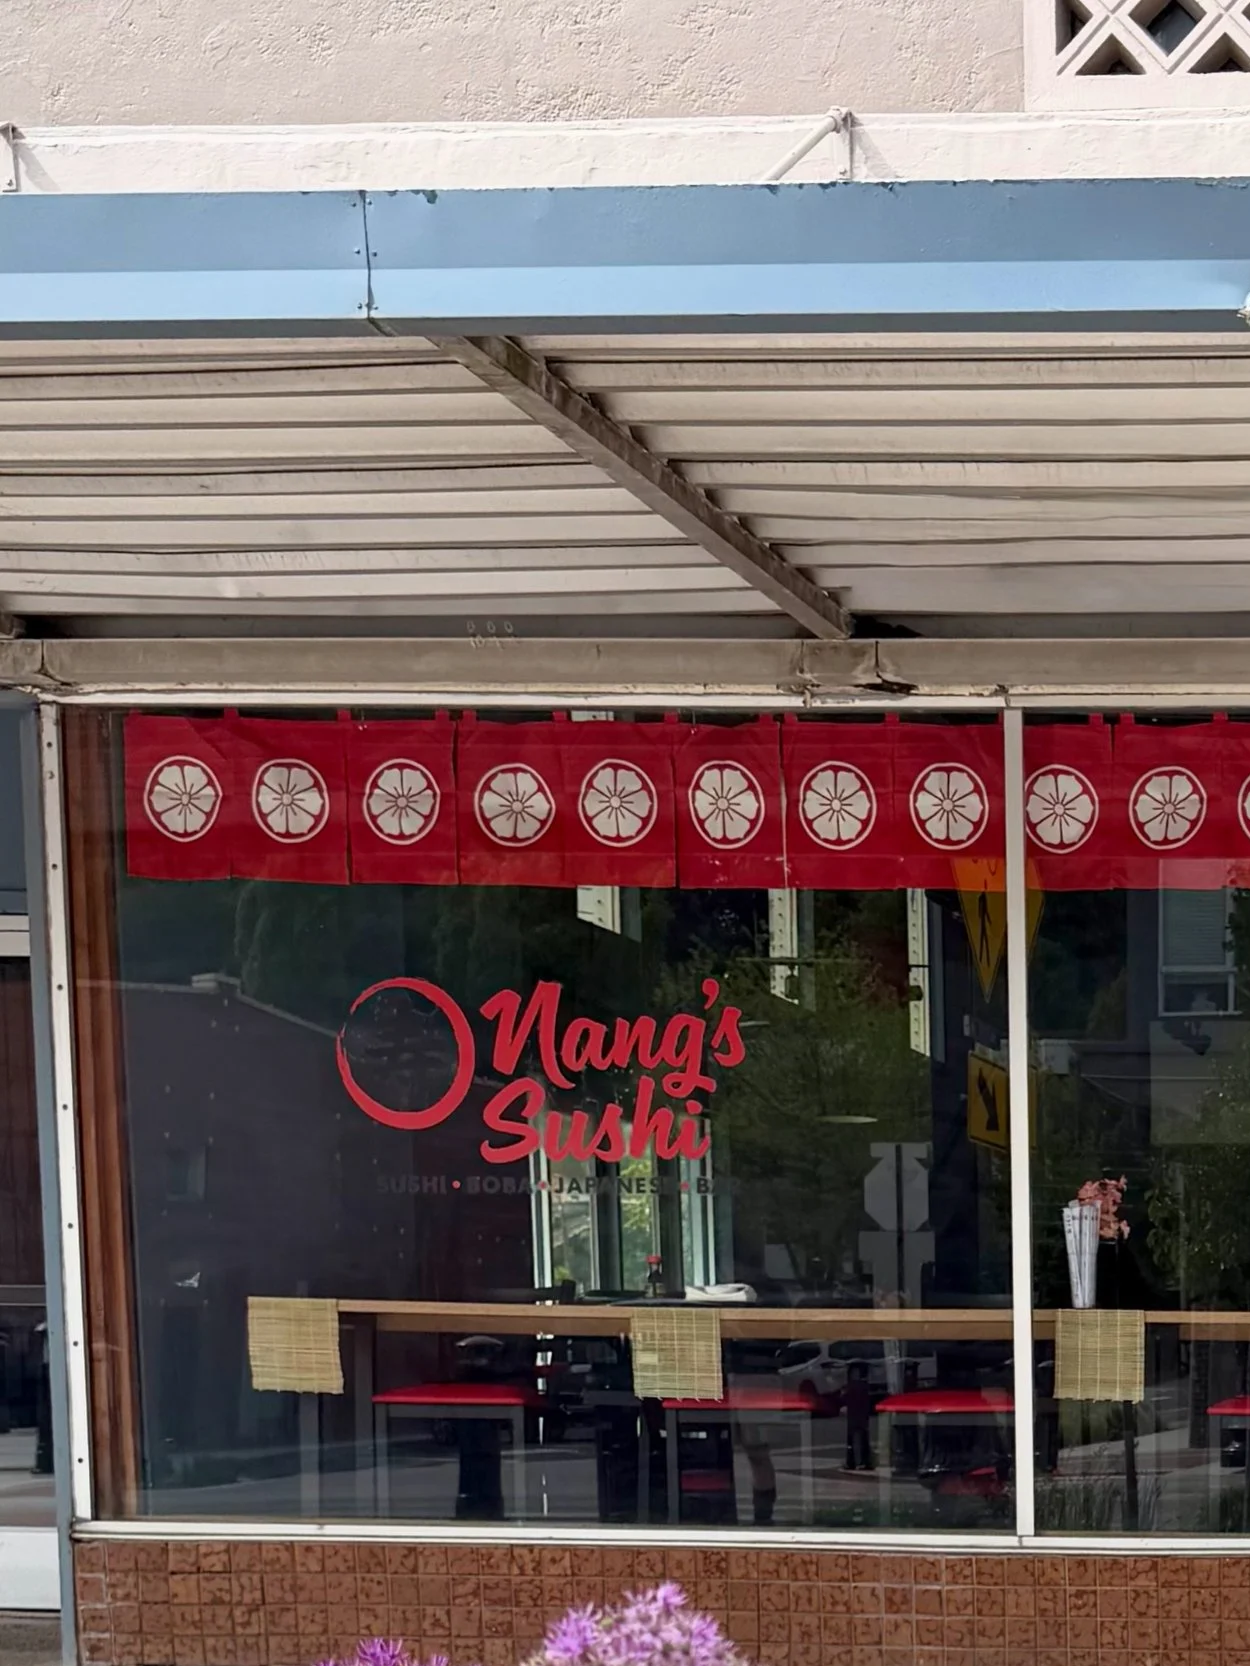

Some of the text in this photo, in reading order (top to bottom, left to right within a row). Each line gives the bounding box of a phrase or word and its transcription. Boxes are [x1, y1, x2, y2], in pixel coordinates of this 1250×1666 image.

[481, 980, 743, 1097] Nang's
[481, 1077, 709, 1162] Sushi
[376, 1175, 447, 1194] SUSHI
[465, 1175, 532, 1195] BOBA
